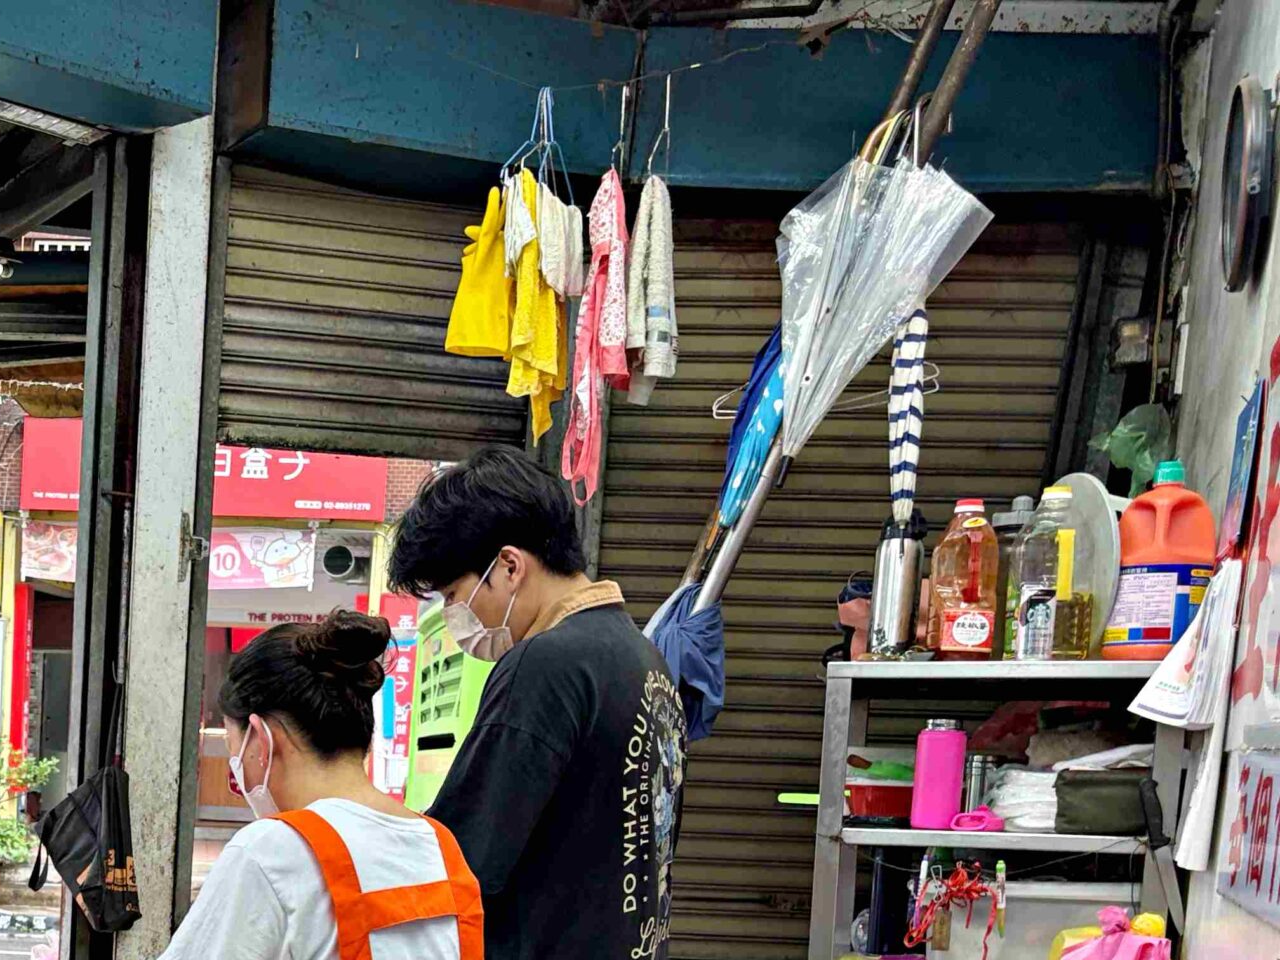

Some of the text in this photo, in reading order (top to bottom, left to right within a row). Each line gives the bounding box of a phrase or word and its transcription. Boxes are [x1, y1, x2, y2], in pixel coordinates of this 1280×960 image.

[213, 552, 236, 567] 10
[248, 613, 268, 623] THE
[272, 613, 314, 623] PROTEIN
[623, 713, 647, 775] YOU
[623, 787, 637, 866] WHAT
[640, 814, 649, 845] THE
[623, 873, 637, 913] DO
